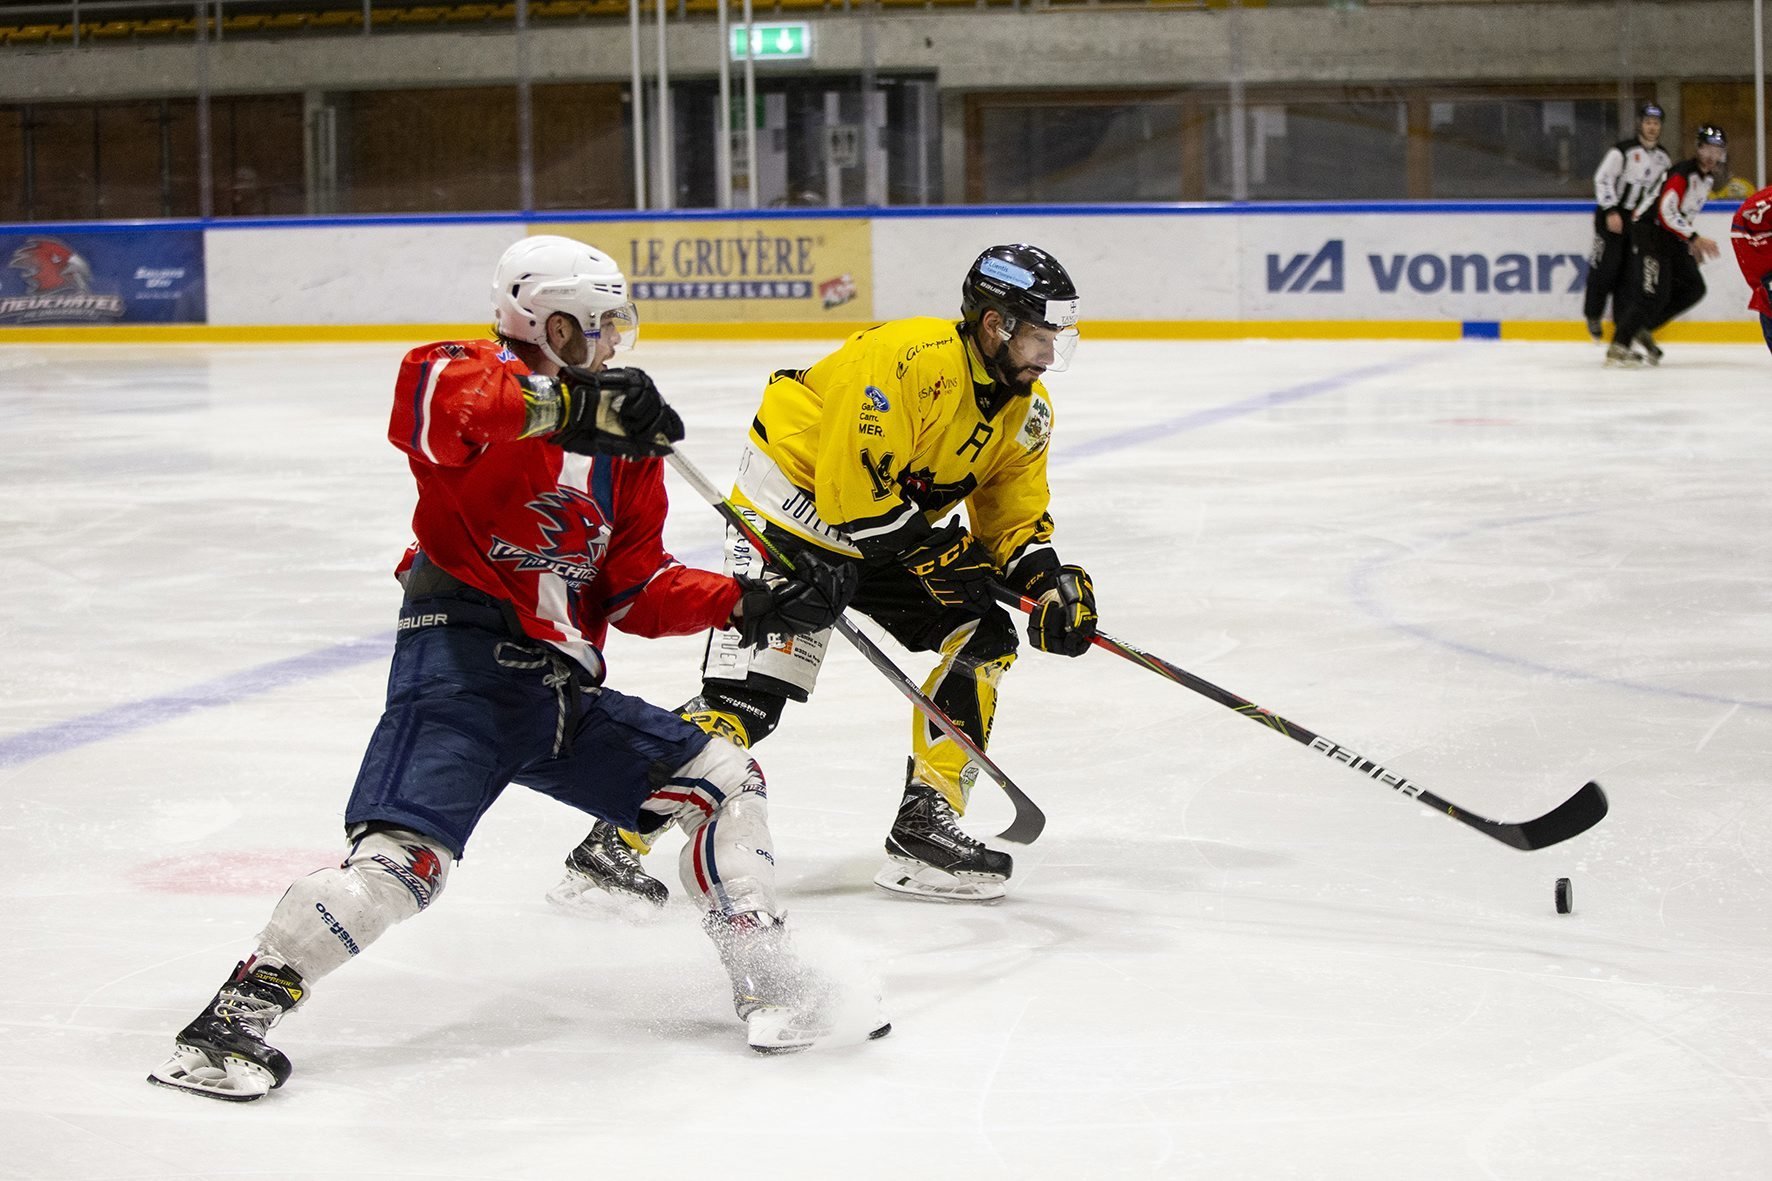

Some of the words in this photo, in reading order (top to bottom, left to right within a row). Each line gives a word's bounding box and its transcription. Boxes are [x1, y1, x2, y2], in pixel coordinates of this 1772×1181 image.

[630, 239, 664, 277] LE
[673, 231, 815, 278] GRUYÈRE
[1367, 253, 1590, 294] vonarx
[636, 283, 808, 298] SWITZERLAND
[980, 281, 1006, 297] BAUER
[914, 531, 975, 576] CCM
[1025, 571, 1046, 591] CCM
[904, 678, 926, 698] BAUER
[1307, 736, 1426, 797] BAUER
